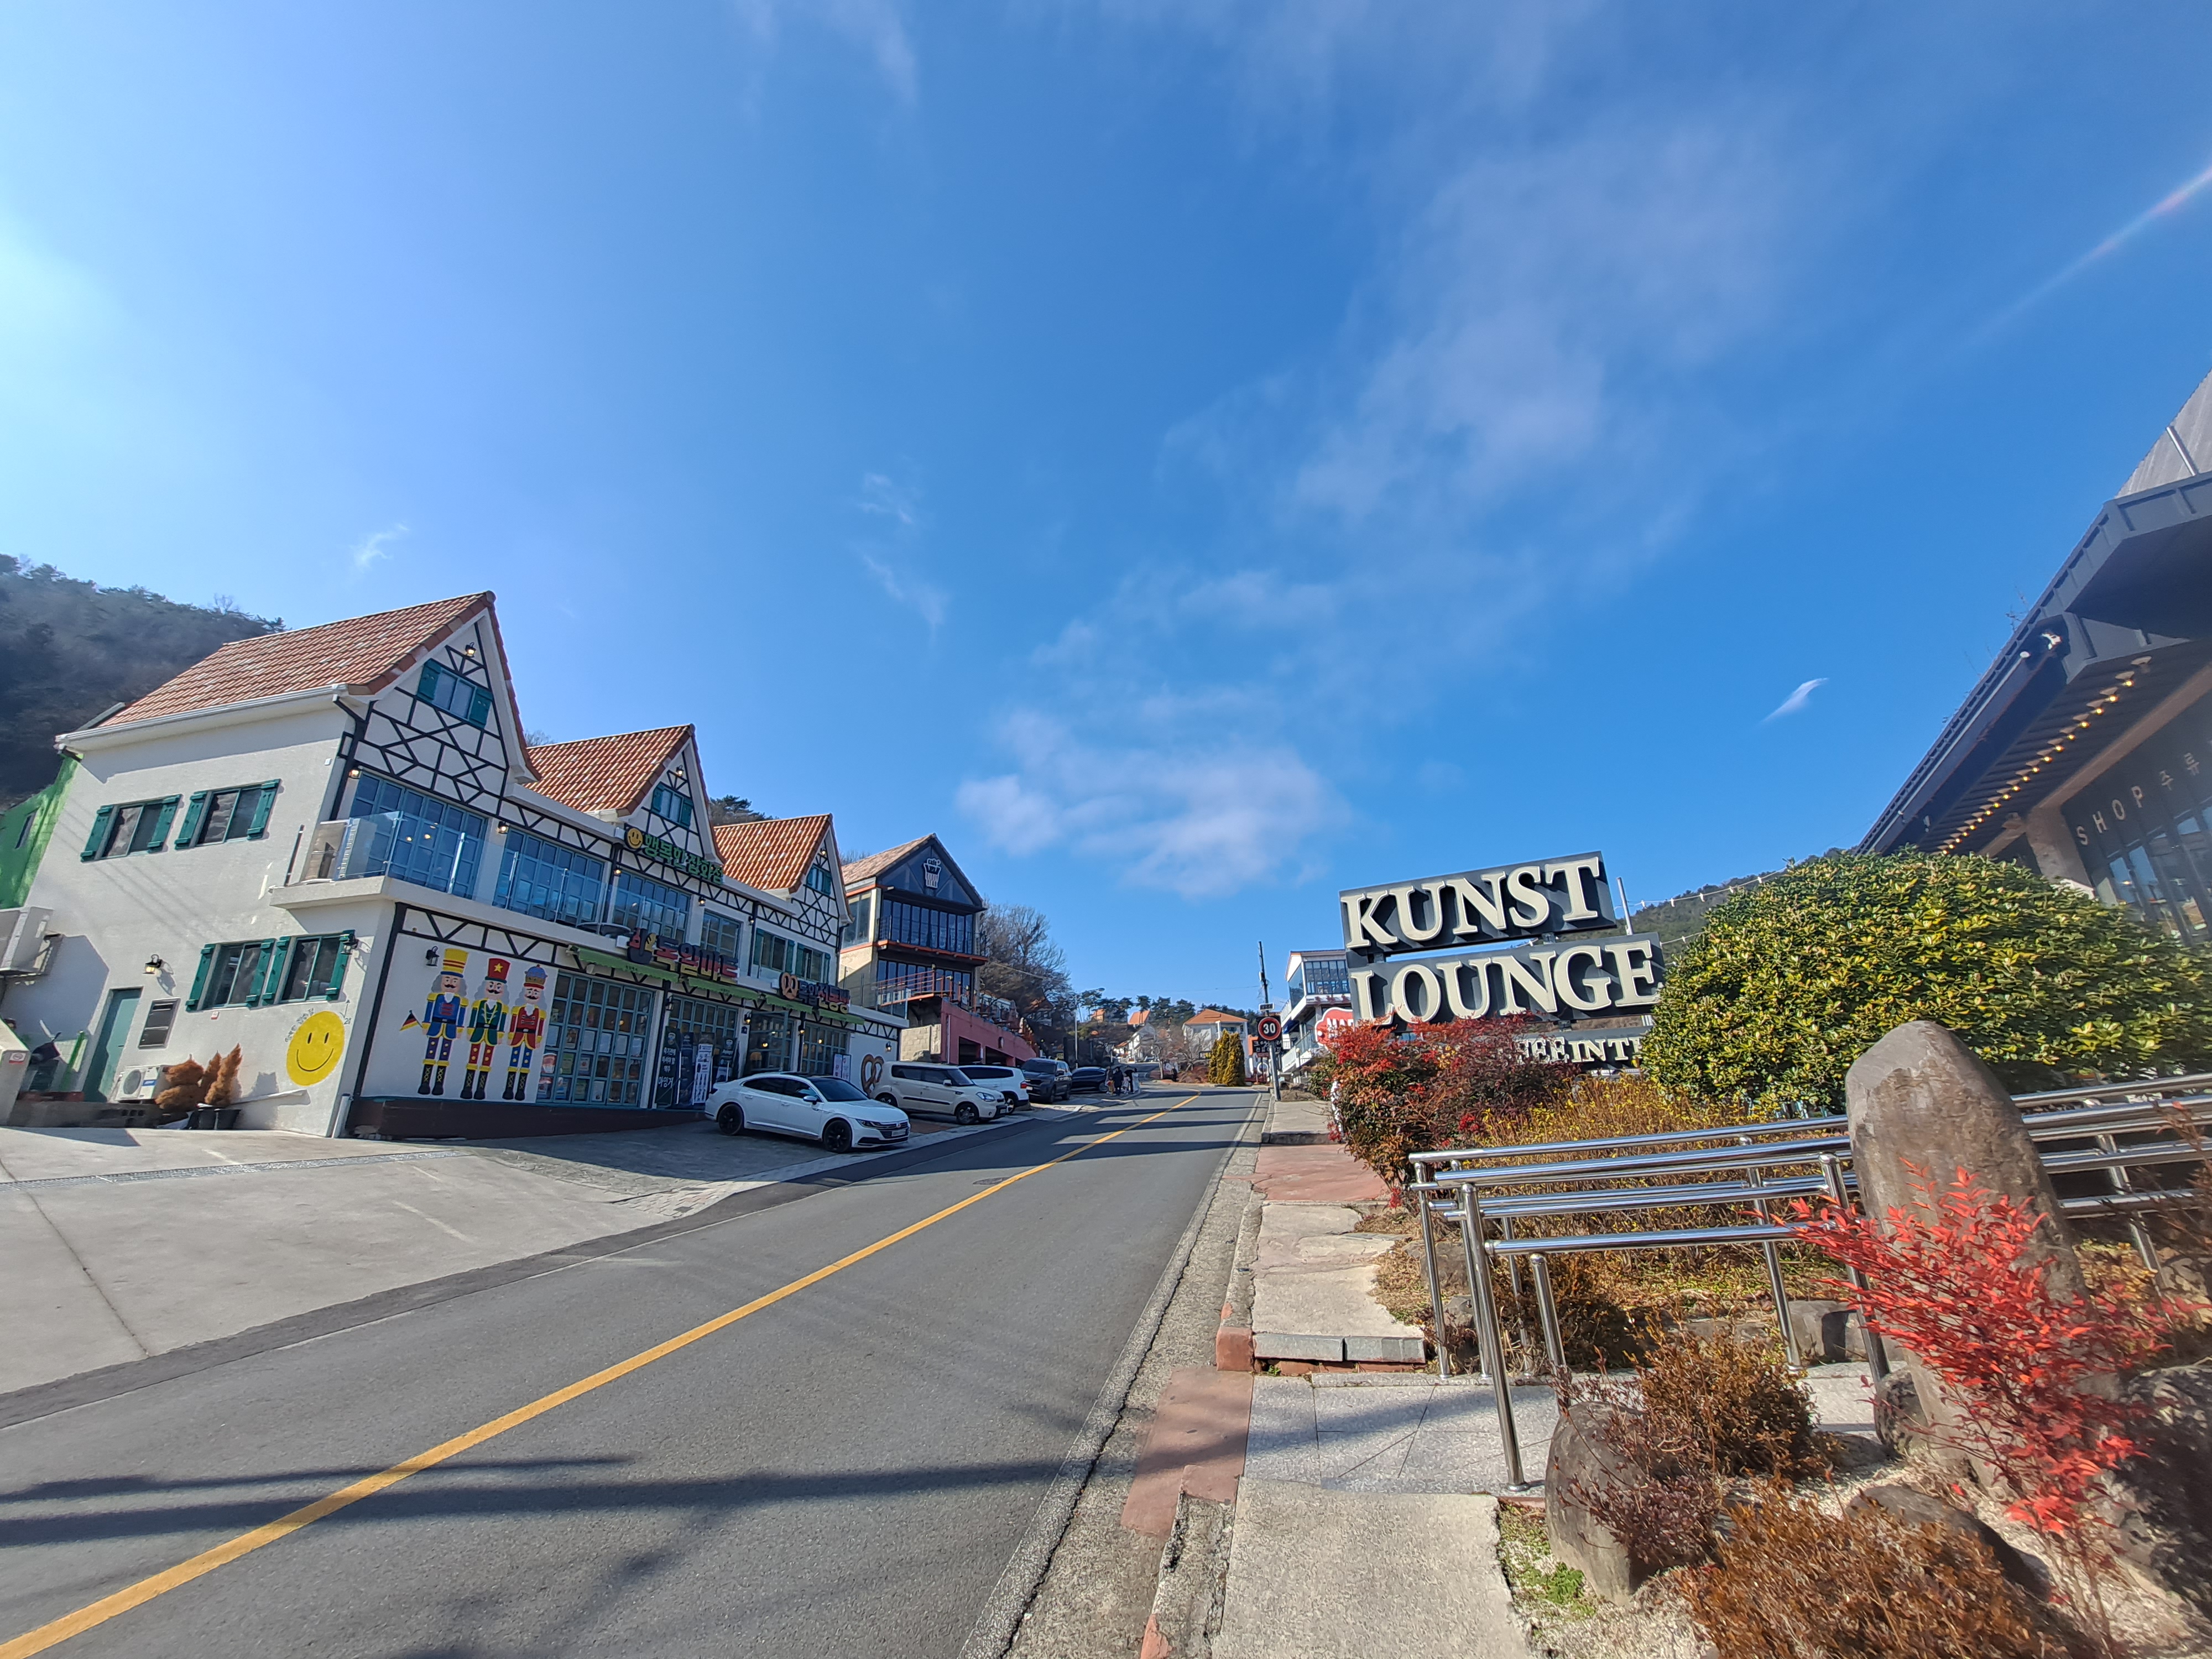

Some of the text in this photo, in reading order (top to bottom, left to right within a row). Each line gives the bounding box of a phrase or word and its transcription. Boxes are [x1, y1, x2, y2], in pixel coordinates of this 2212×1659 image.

[2077, 785, 2144, 846] SHOP
[644, 834, 687, 869] 행복한
[1340, 856, 1600, 948] KUNST
[655, 935, 738, 984] 독일마트
[1350, 940, 1660, 1026] LOUNGE
[1263, 1022, 1276, 1034] 30
[658, 1076, 674, 1088] 아잉거
